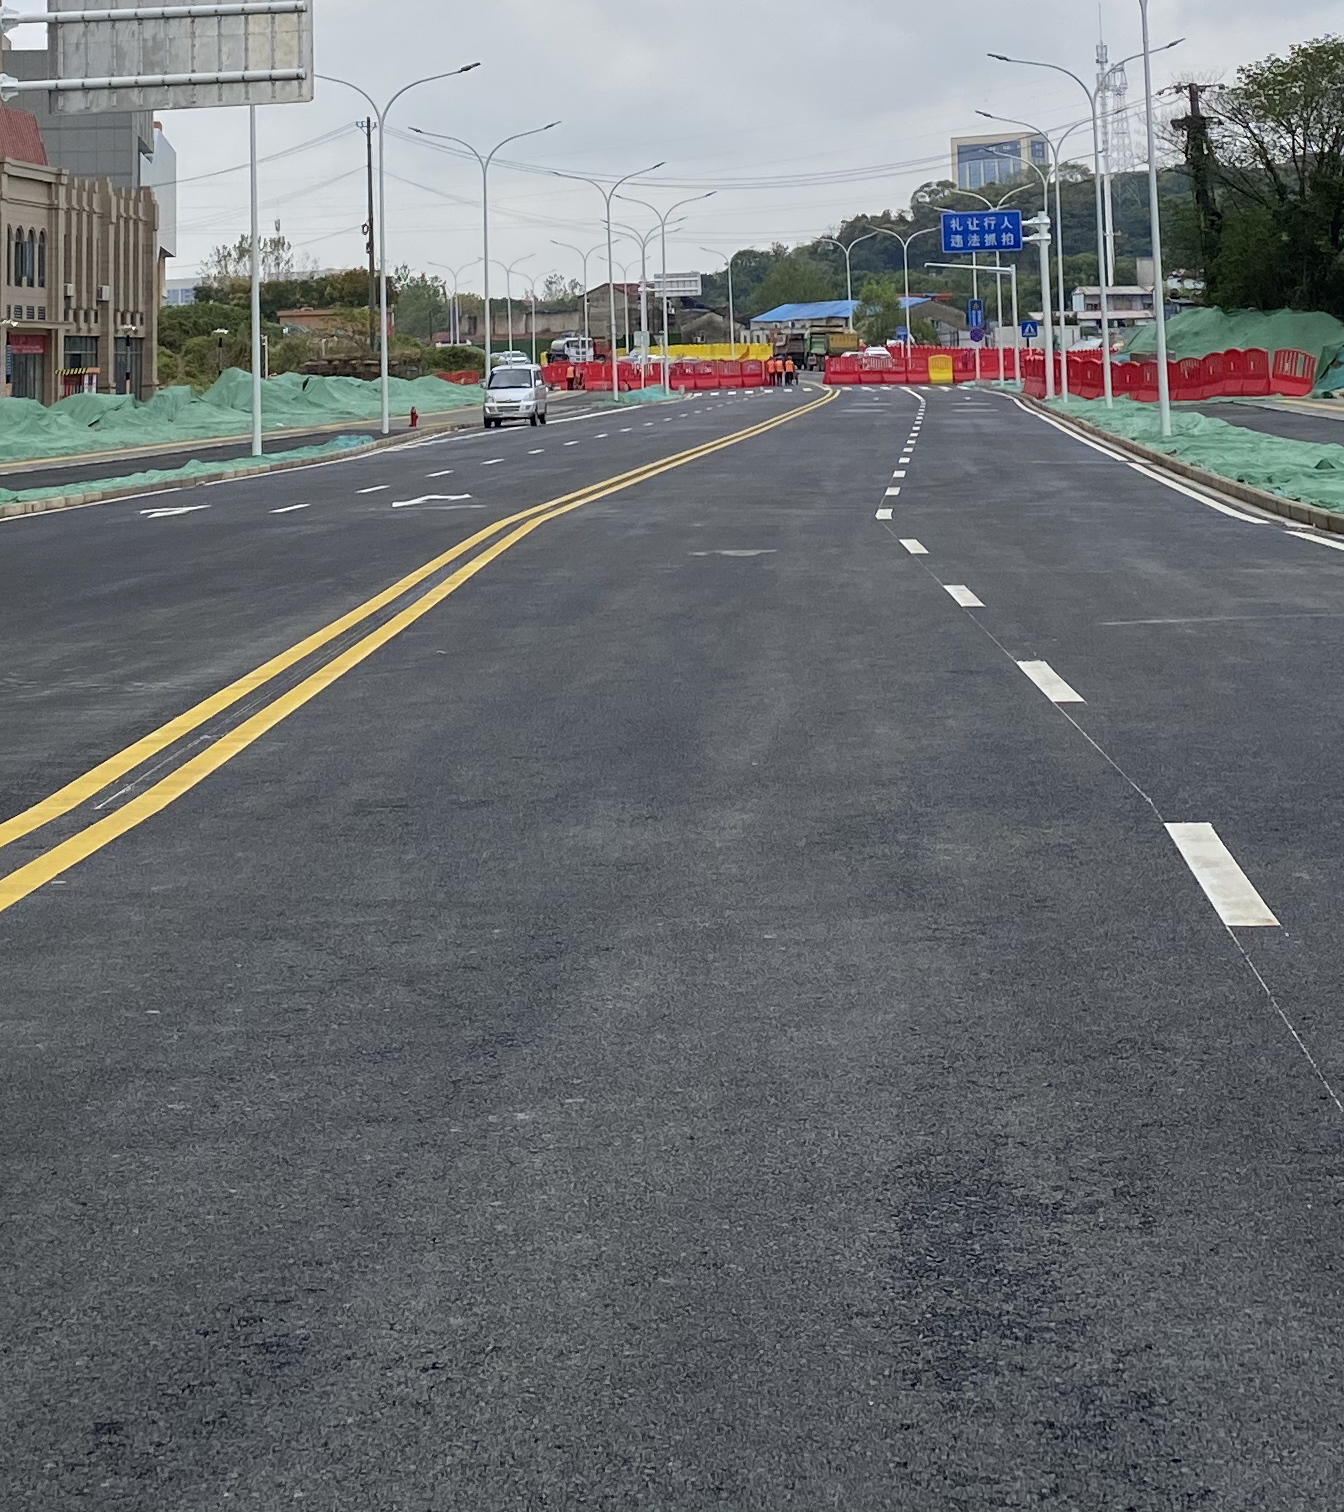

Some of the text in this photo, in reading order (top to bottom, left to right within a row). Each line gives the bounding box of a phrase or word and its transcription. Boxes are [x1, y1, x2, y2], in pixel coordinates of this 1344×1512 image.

[950, 216, 1013, 231] 礼让行人
[950, 233, 1014, 248] 违法抓拍
